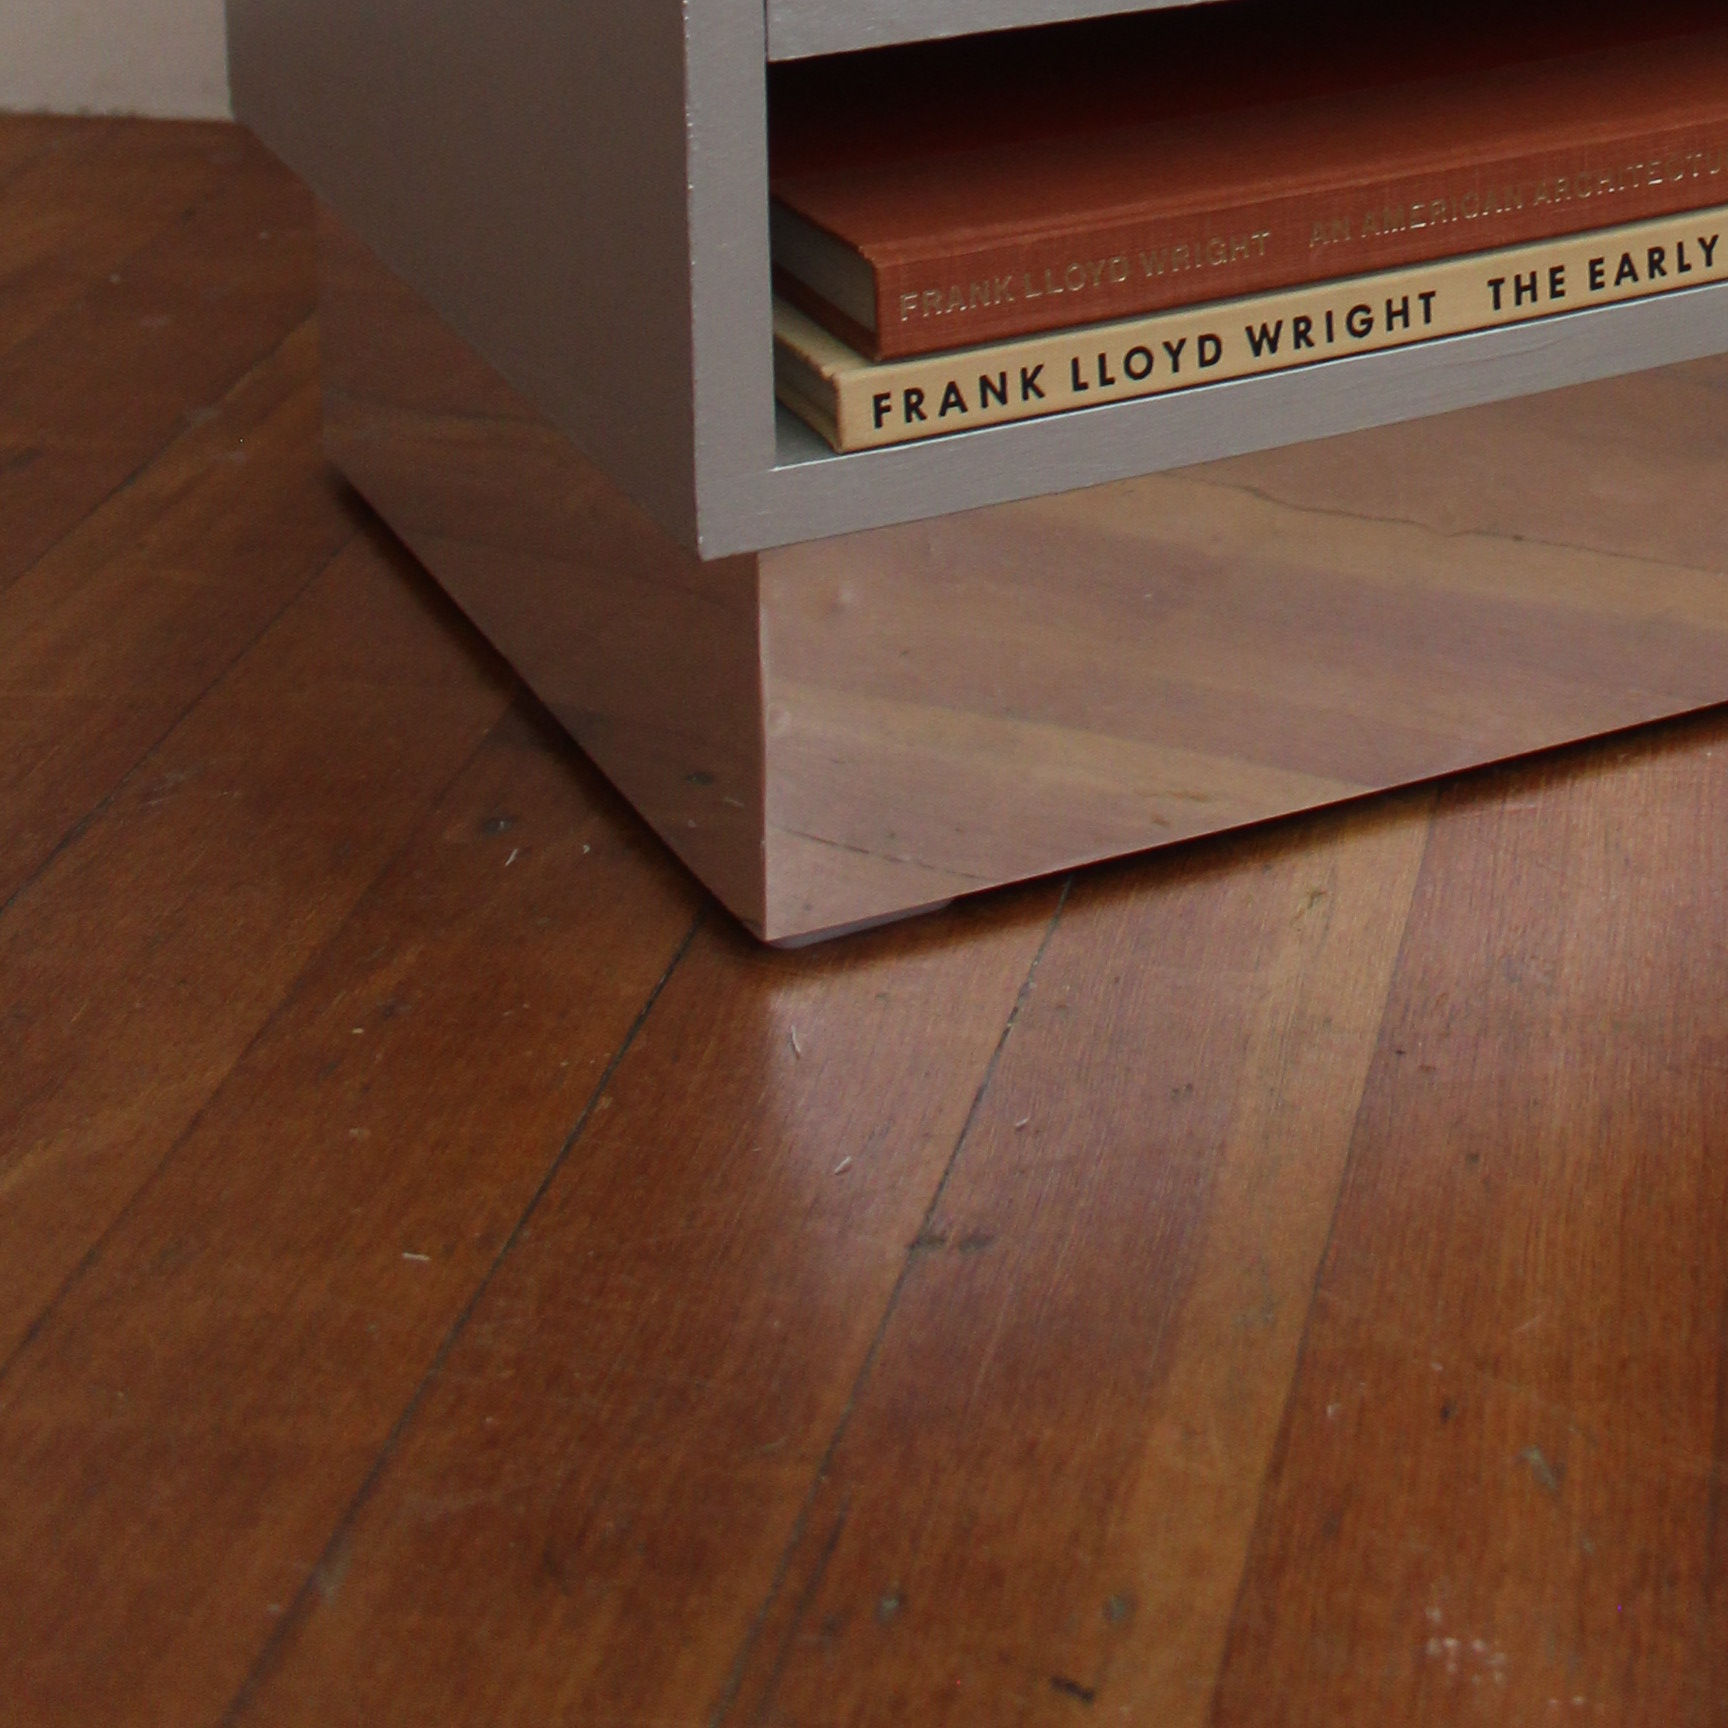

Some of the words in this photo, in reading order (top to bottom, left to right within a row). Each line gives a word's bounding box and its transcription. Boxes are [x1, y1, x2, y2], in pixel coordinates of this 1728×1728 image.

[872, 363, 1046, 429] FRANK
[1070, 331, 1222, 393] LLOYD
[1245, 290, 1437, 359] WRIGHT
[1487, 264, 1567, 311] THE
[1587, 234, 1719, 292] EARLY
[899, 272, 1017, 322] FRANK
[1023, 251, 1131, 300] LLOYD
[1137, 230, 1272, 278] WRIGHT
[1360, 183, 1524, 238] AMERICAN
